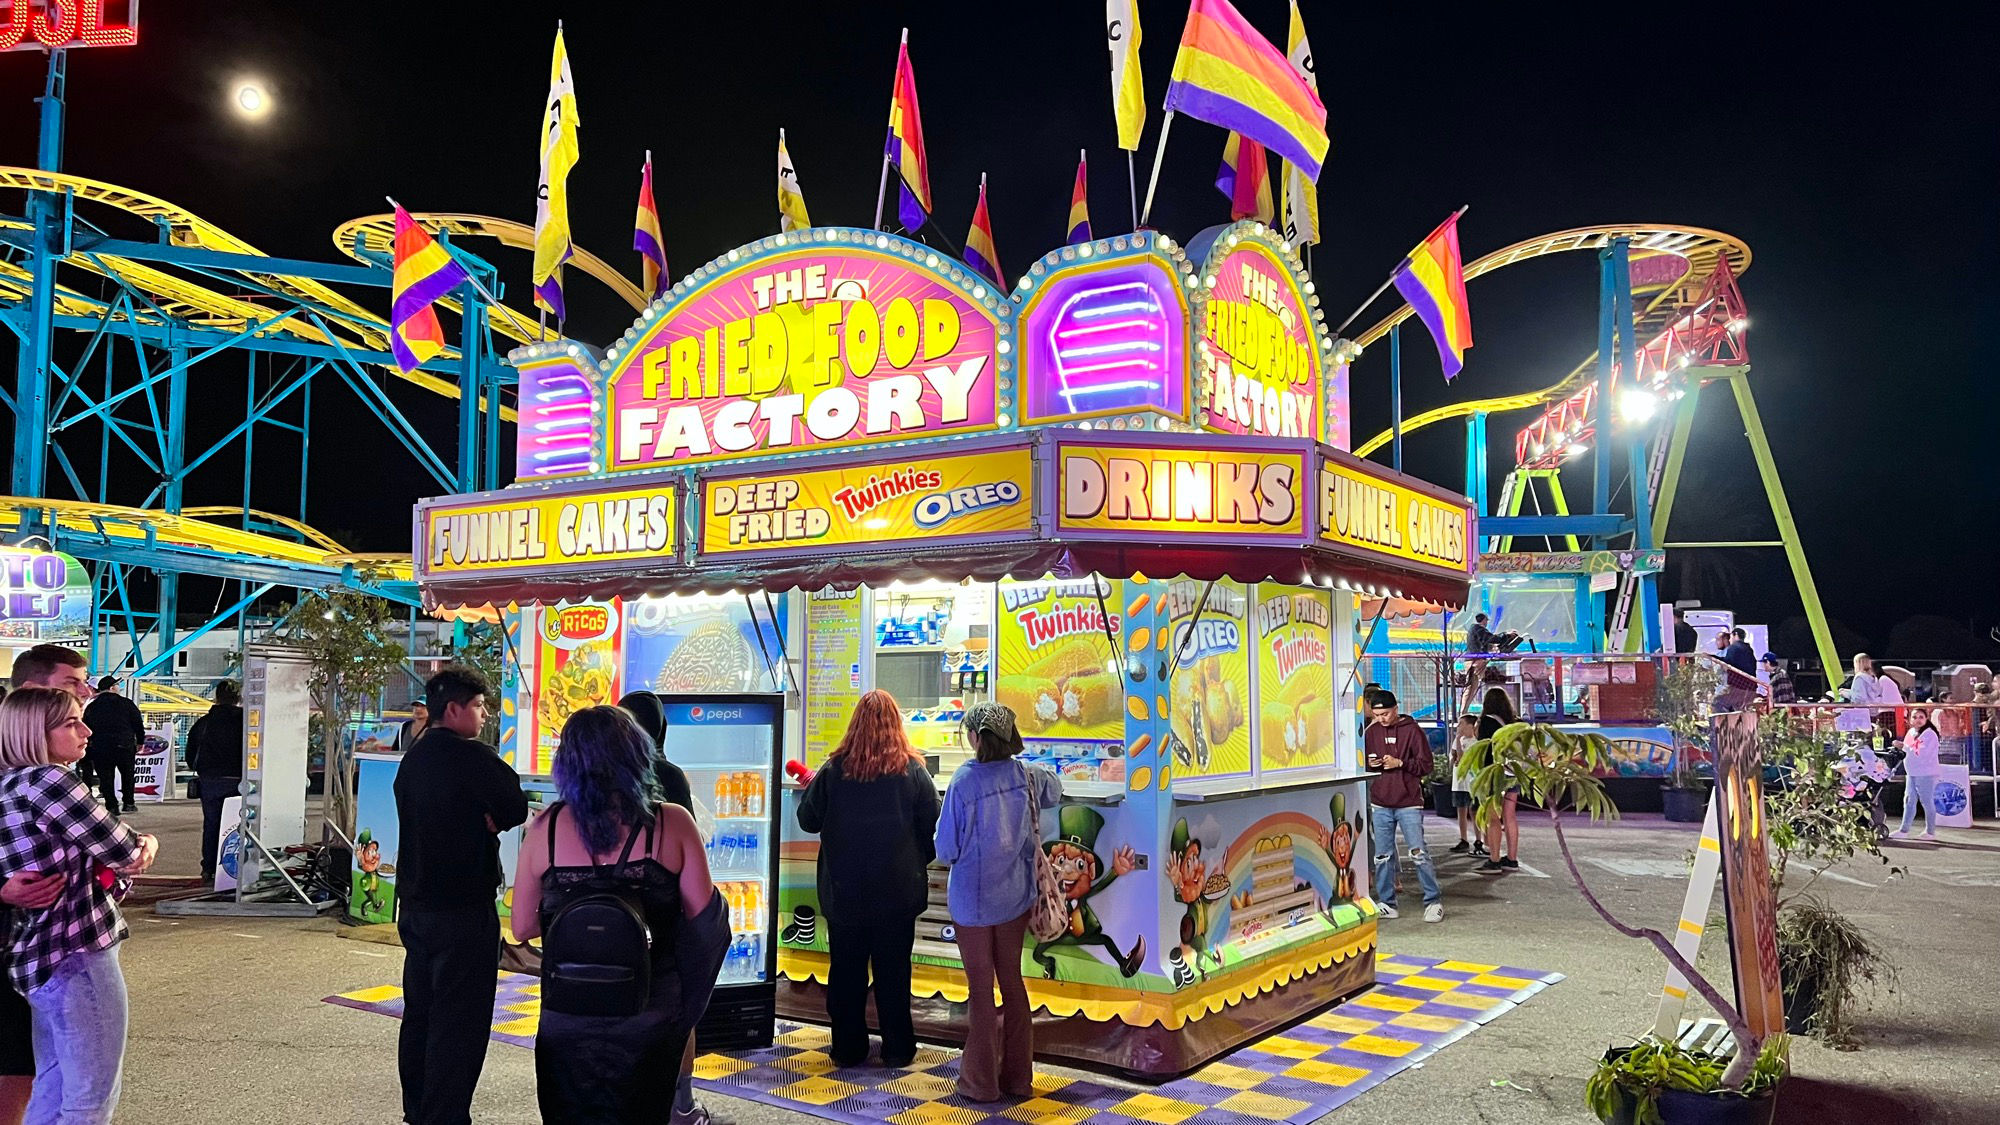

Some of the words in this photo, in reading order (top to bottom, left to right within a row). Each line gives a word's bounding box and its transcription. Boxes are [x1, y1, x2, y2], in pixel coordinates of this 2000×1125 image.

[753, 264, 827, 310] THE
[1242, 262, 1278, 315] THE
[642, 311, 788, 400] FRIED
[813, 297, 961, 387] FOOD
[1206, 300, 1259, 370] FRIED
[1265, 316, 1310, 385] FOOD
[619, 355, 990, 462] FACTORY
[1202, 350, 1314, 438] FACTORY
[714, 480, 800, 516] DEEP
[834, 469, 942, 520] Twinkies
[915, 481, 1020, 527] OREO
[1065, 456, 1295, 526] DRINKS
[433, 508, 546, 567] FUNNEL
[557, 495, 669, 557] CAKES
[729, 508, 831, 545] FRIED
[1320, 469, 1402, 549] FUNNEL
[1408, 499, 1463, 564] CAKES
[0, 554, 66, 591] TO
[1533, 553, 1584, 572] MOUSE
[1002, 586, 1051, 613] DEEP
[1168, 580, 1197, 623] EEP
[1258, 595, 1292, 640] DEEP
[1294, 596, 1330, 630] FRIED
[1020, 604, 1121, 646] Twinkies
[1174, 619, 1240, 666] OREO
[1272, 630, 1326, 681] Twinkies
[680, 671, 709, 687] OREO
[706, 708, 742, 720] pepsi
[134, 757, 148, 766] CK
[148, 757, 165, 766] OUT
[134, 775, 156, 783] OTOS
[135, 766, 152, 775] OUR
